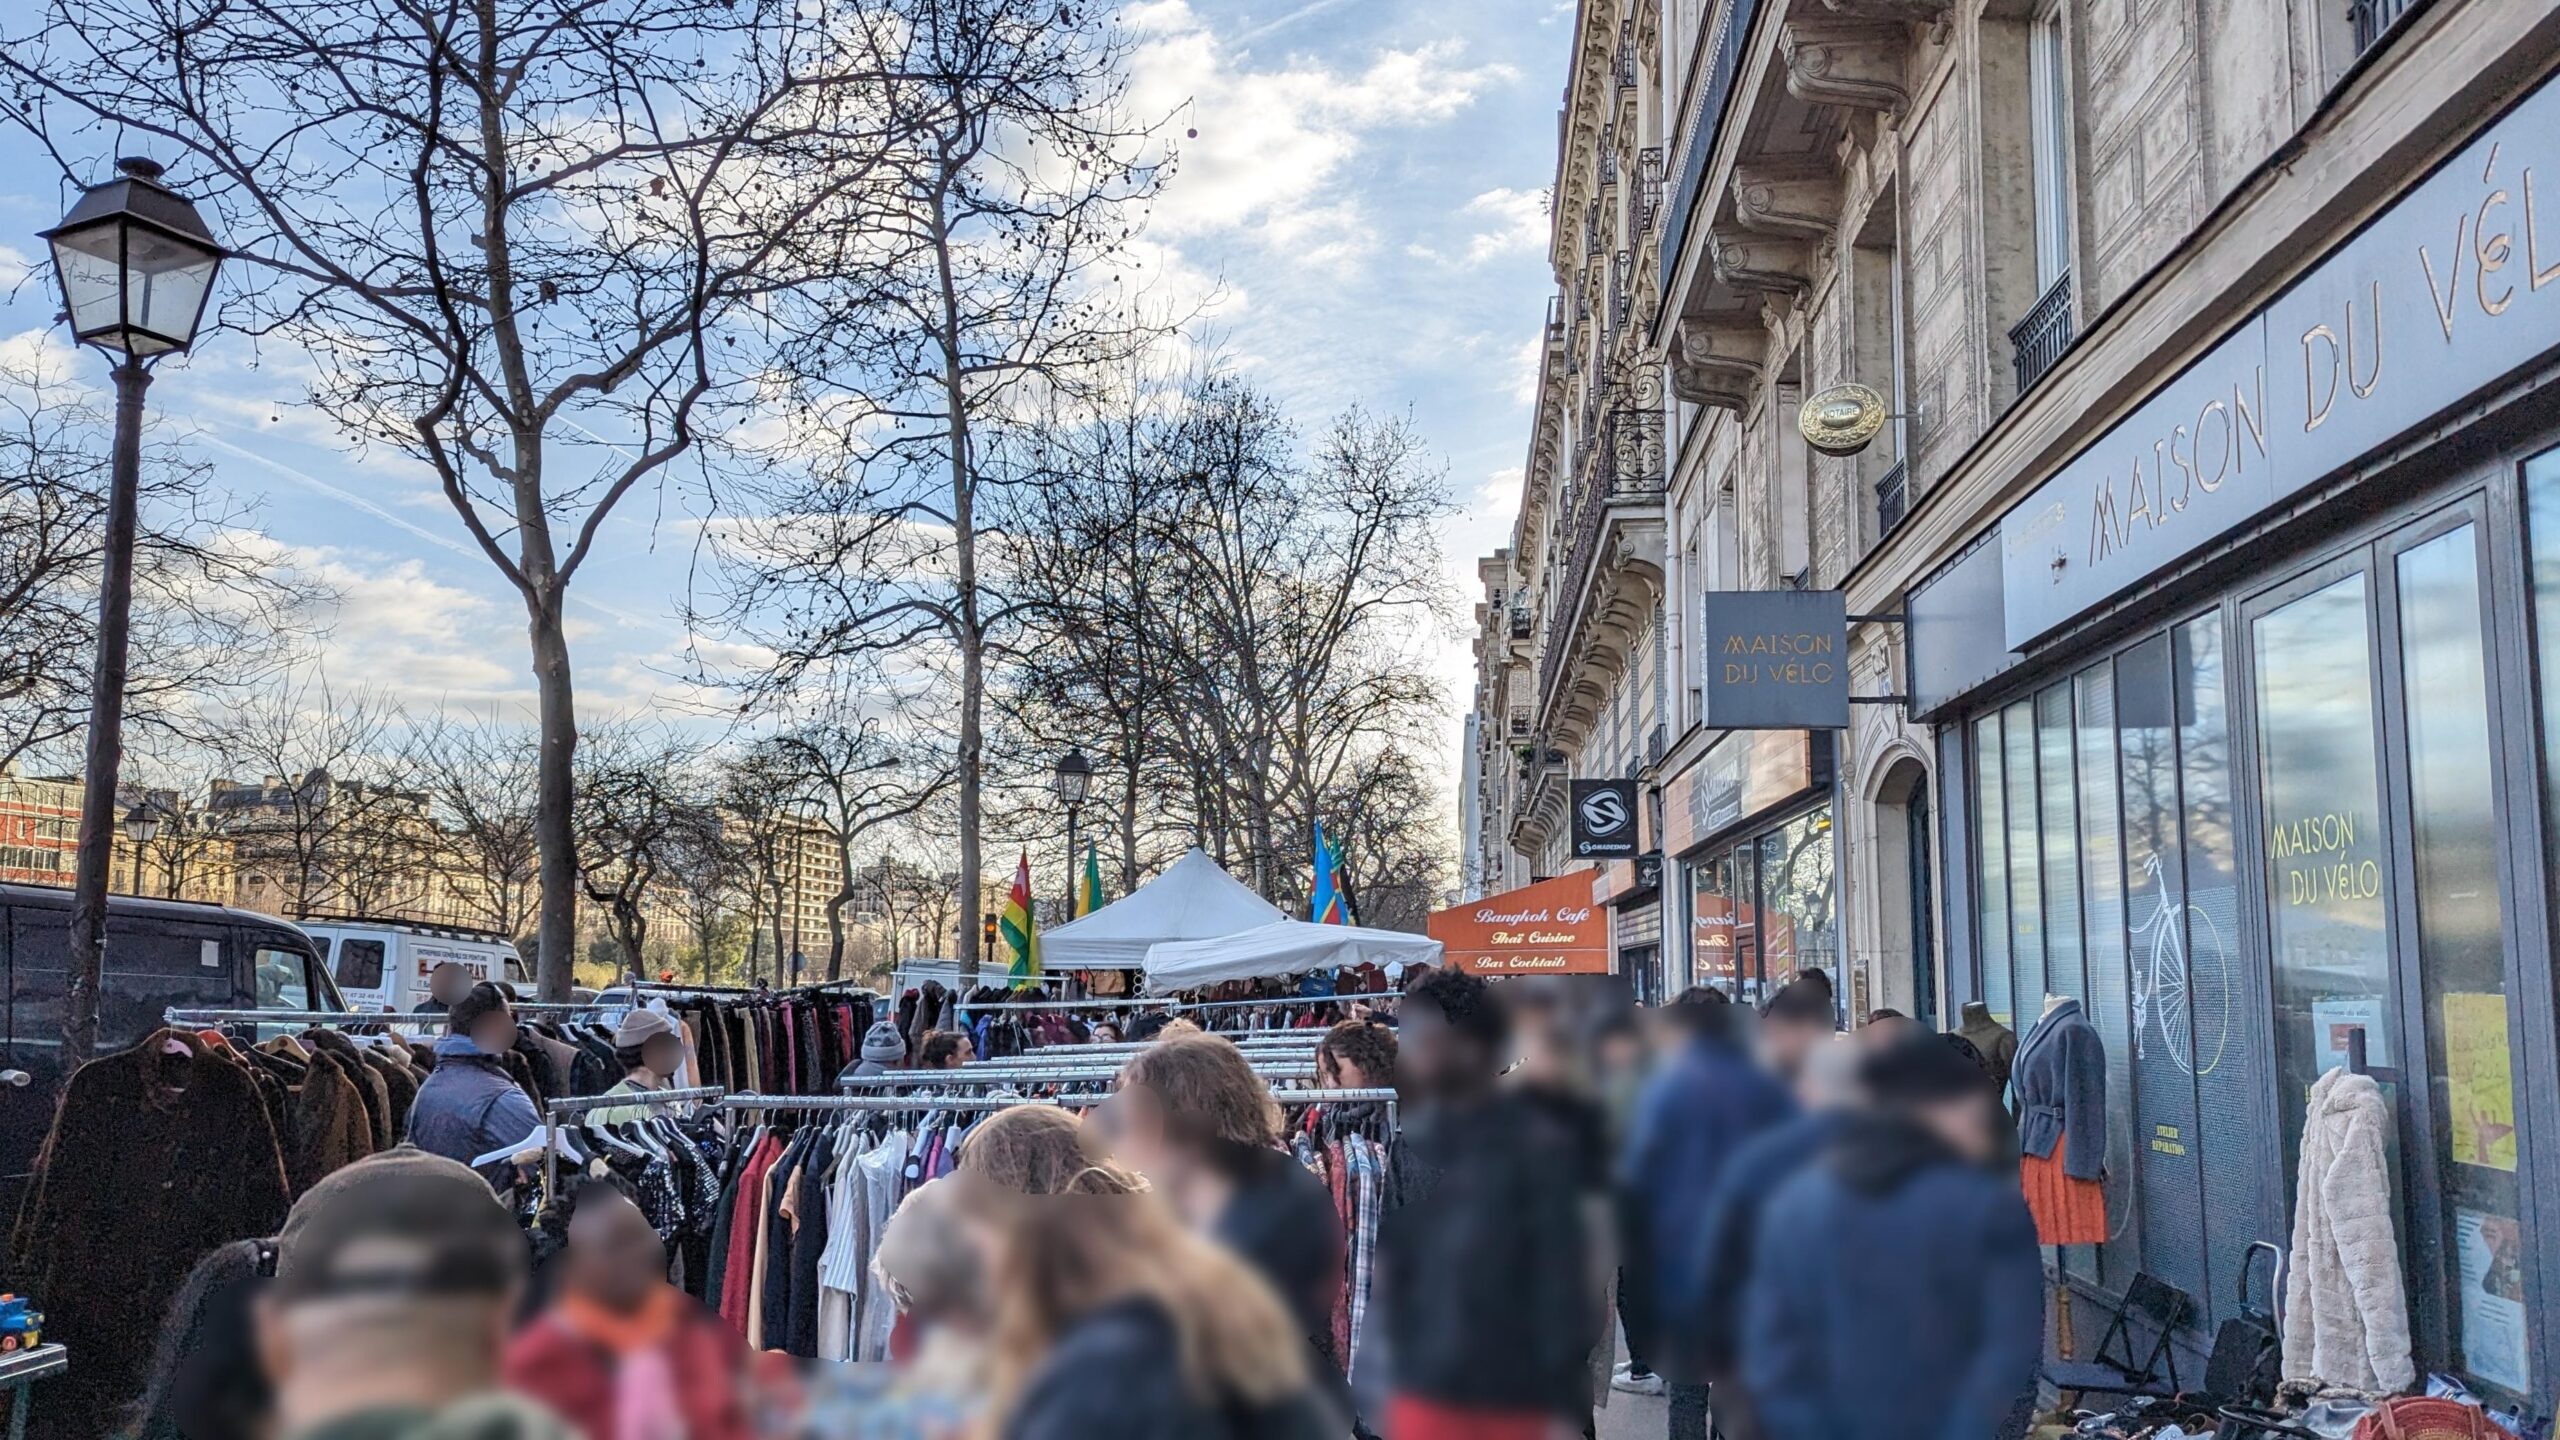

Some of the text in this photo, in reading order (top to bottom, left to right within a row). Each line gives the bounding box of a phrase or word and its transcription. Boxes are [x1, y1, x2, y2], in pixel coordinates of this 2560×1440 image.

[2089, 142, 2560, 567] MAISON DU VÉL
[1824, 406, 1858, 418] NOTAIRE
[1723, 634, 1832, 655] MAISON
[1725, 656, 1832, 684] DU VÉLO
[2271, 810, 2354, 859] MAISON
[2291, 850, 2378, 905] DU VÉLO
[1474, 906, 1591, 926] Bangkok Café
[1491, 931, 1576, 944] Thaï Cuisine
[1475, 955, 1566, 969] Bar Cocktails
